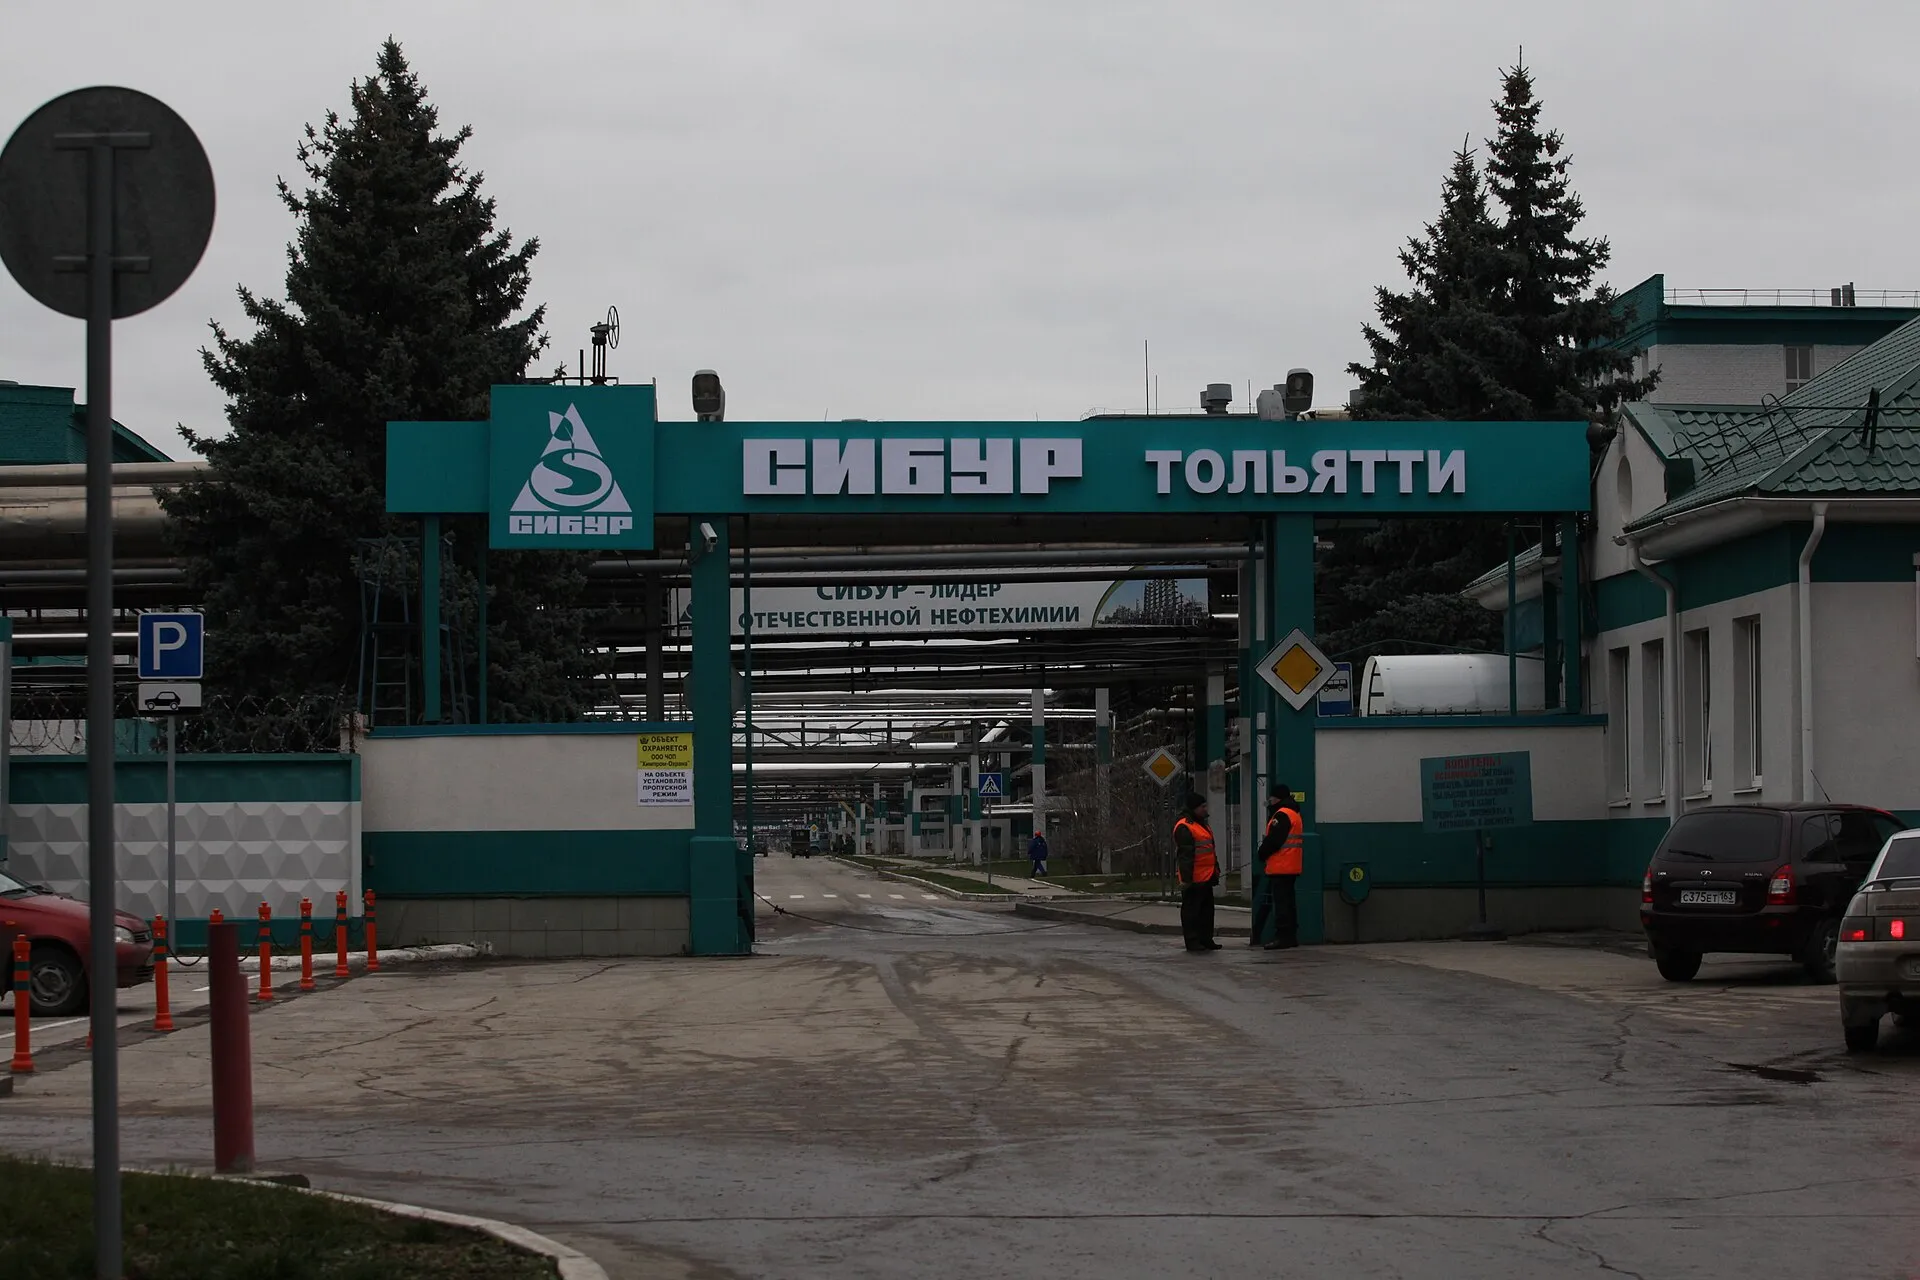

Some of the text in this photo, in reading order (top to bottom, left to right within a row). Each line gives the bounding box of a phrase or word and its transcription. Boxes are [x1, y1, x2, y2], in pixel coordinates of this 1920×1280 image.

[743, 438, 1465, 495] СИБУР ТОЛЬЯТТИ
[509, 515, 632, 535] СИБУР
[930, 583, 1002, 601] ЛИДЕР
[738, 606, 1080, 629] ОТЕЧЕСТВЕННОЙ НЕФТЕХИМИИ
[153, 621, 187, 670] P
[1720, 892, 1734, 900] 163
